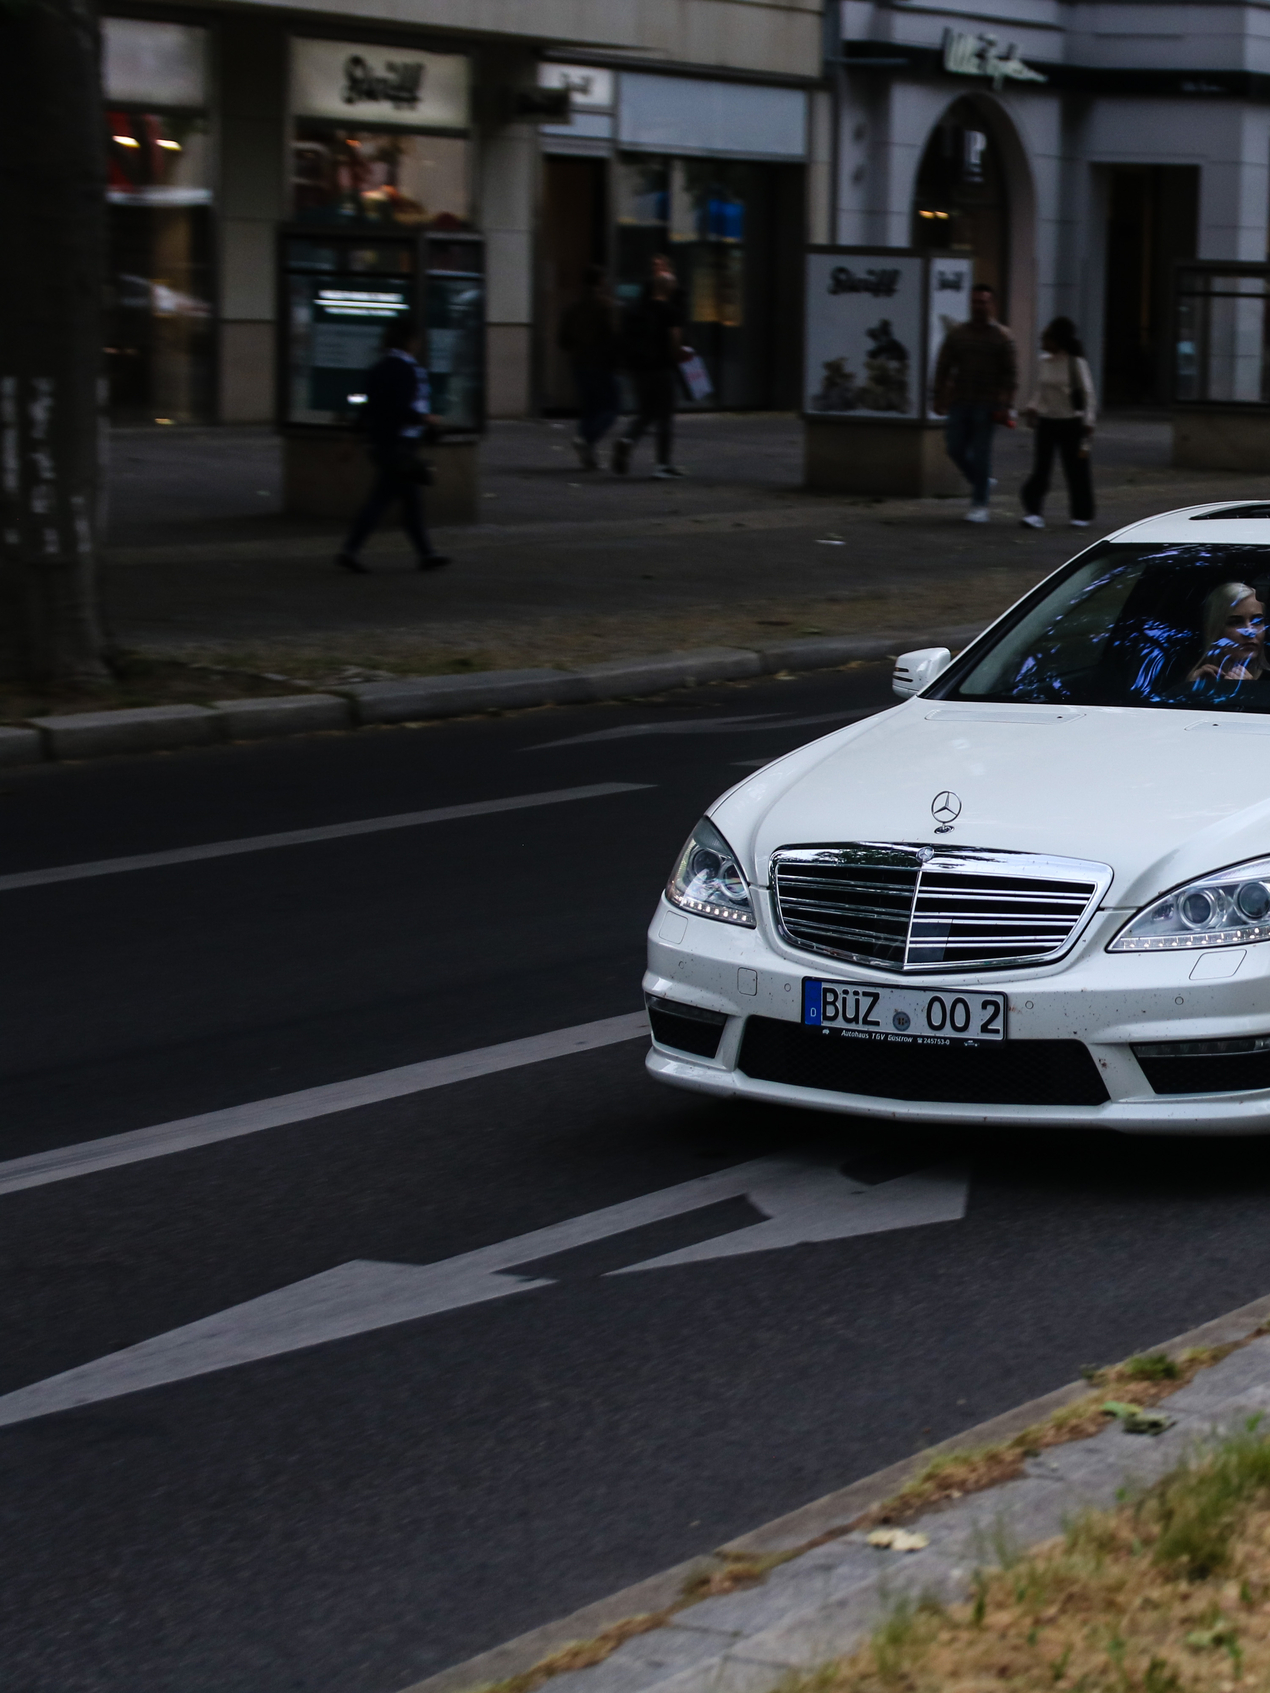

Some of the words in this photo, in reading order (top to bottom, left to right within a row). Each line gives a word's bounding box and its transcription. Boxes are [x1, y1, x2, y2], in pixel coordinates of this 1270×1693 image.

[810, 1007, 817, 1017] D
[841, 1029, 869, 1039] Autohaus
[871, 1033, 885, 1041] TGV
